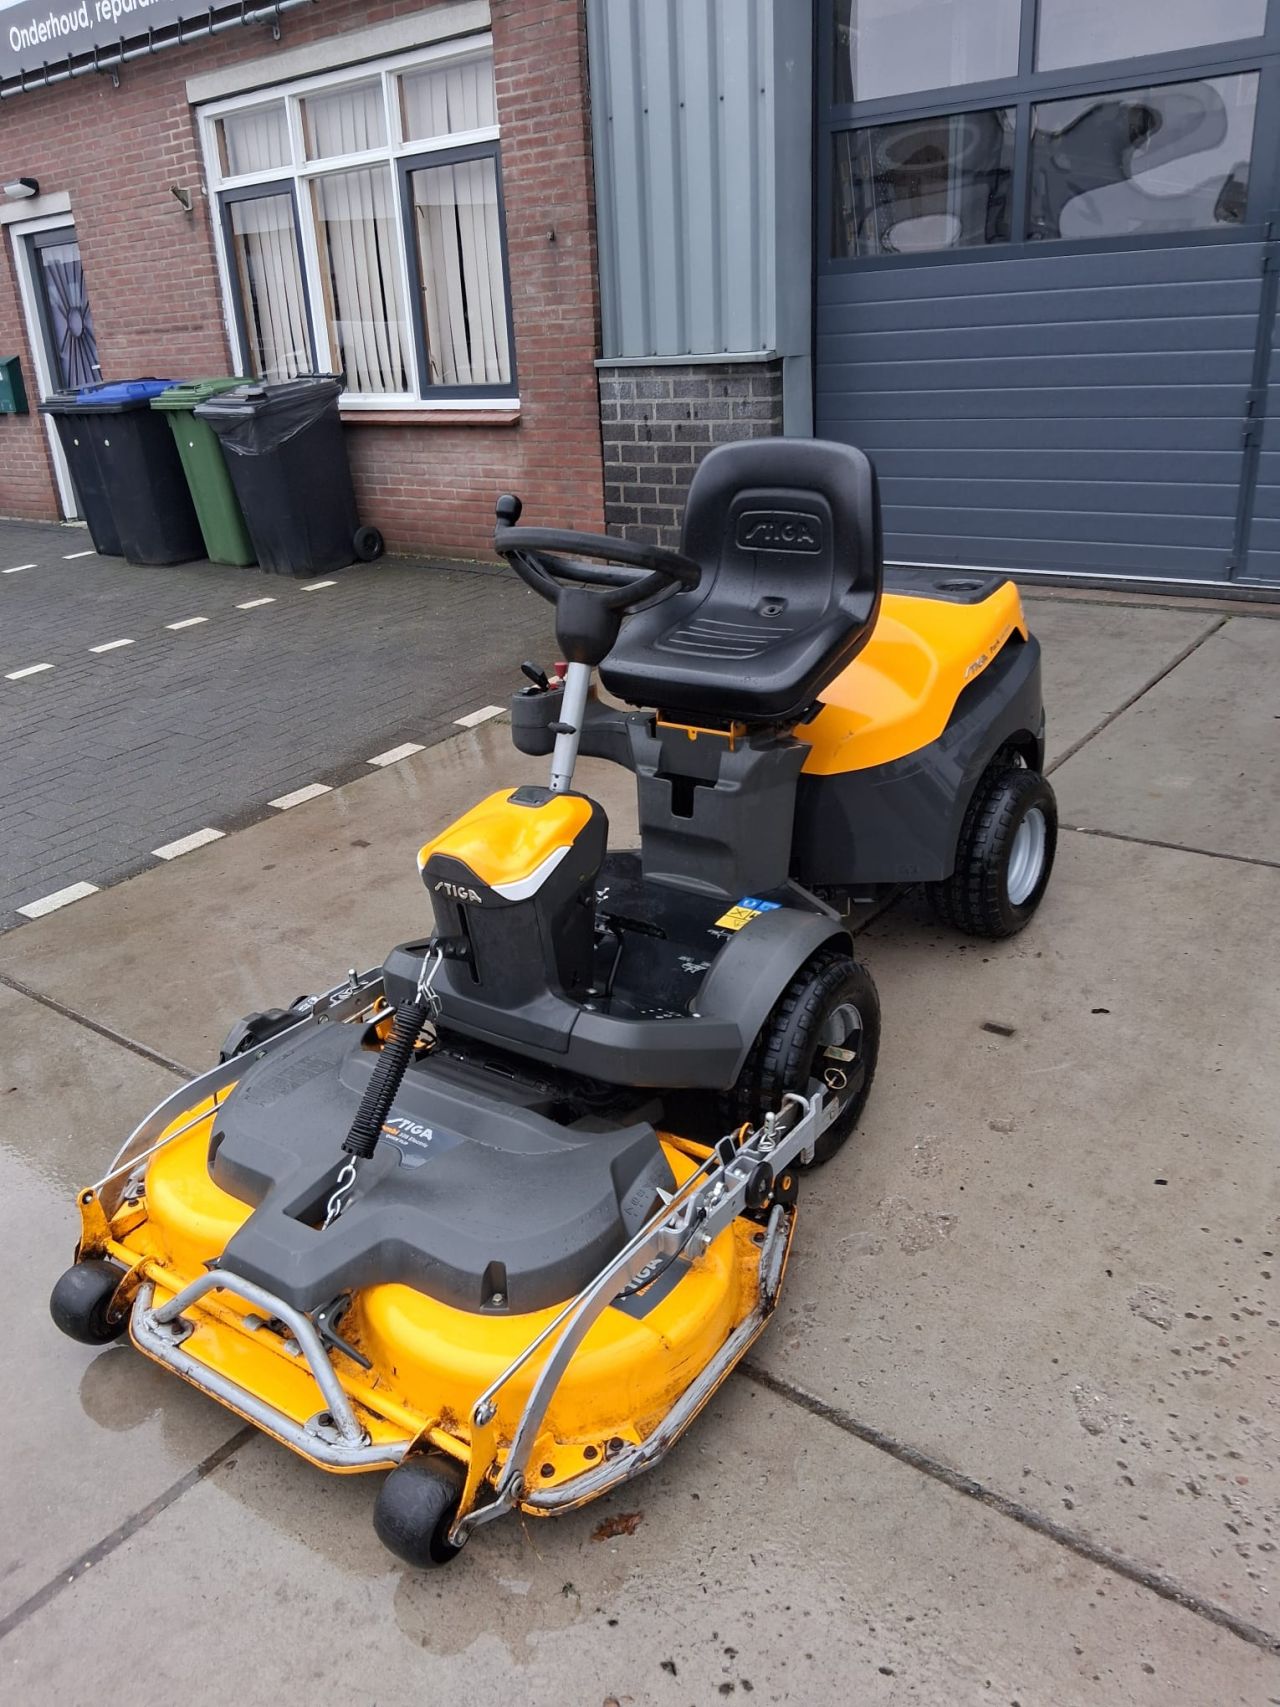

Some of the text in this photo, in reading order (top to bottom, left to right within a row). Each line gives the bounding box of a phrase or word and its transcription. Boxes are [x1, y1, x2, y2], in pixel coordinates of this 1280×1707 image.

[9, 1, 94, 52] Onderhoud,
[745, 523, 815, 544] STIGA
[434, 881, 483, 904] STIGA
[386, 1117, 434, 1142] STIGA
